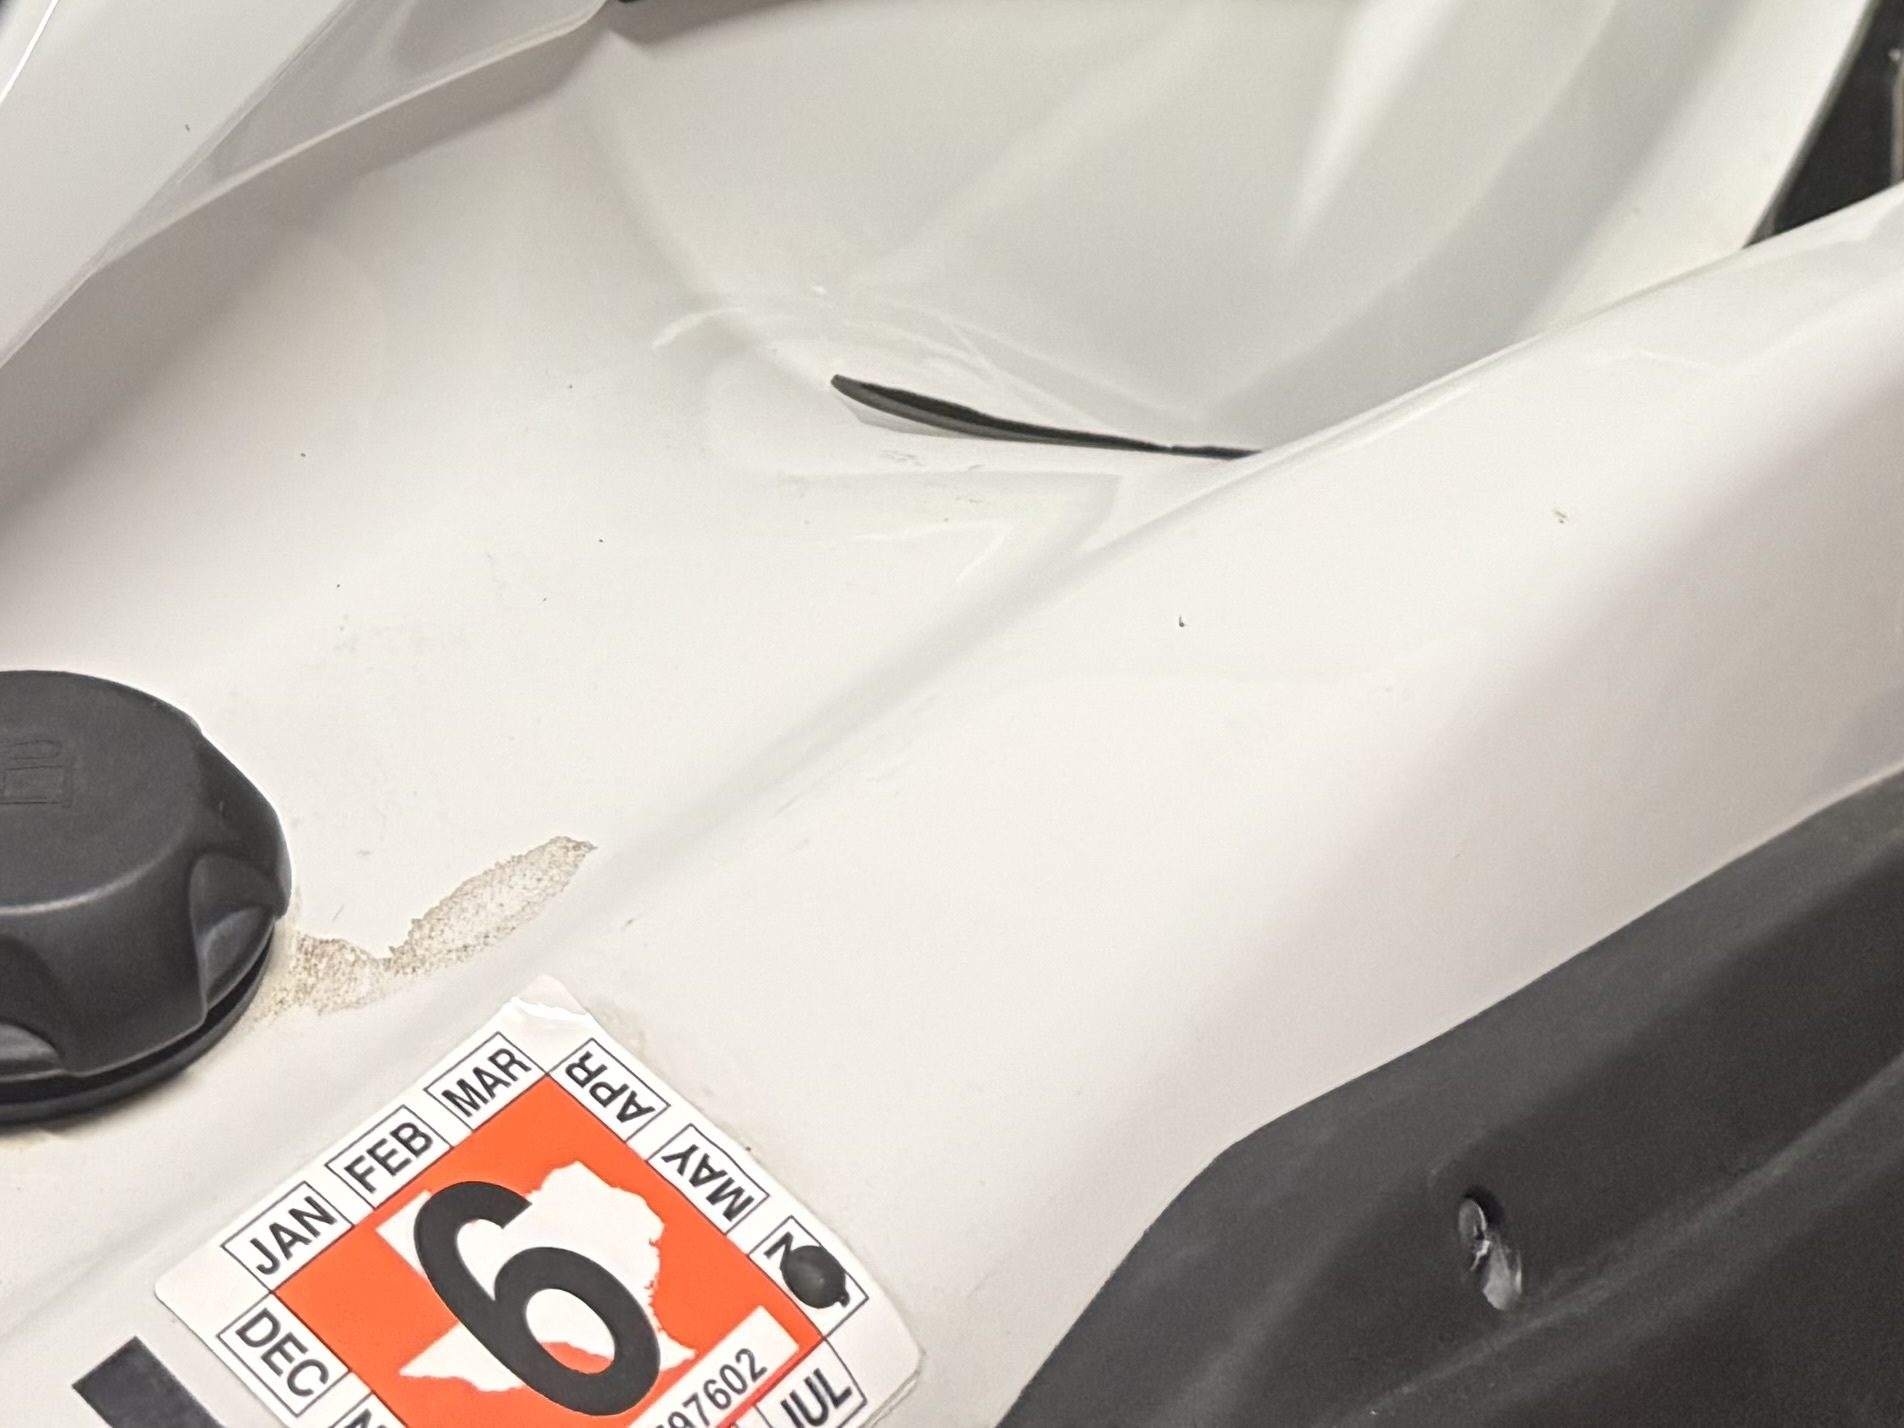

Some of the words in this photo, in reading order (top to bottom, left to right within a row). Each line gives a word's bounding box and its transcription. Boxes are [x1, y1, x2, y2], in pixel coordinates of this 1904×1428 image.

[441, 1047, 533, 1118] MAR
[564, 1050, 657, 1124] APR
[343, 1121, 434, 1195] FEB
[660, 1144, 756, 1223] MAY
[249, 1195, 339, 1276] JAN
[413, 1180, 662, 1417] 6
[234, 1307, 330, 1398] DEC
